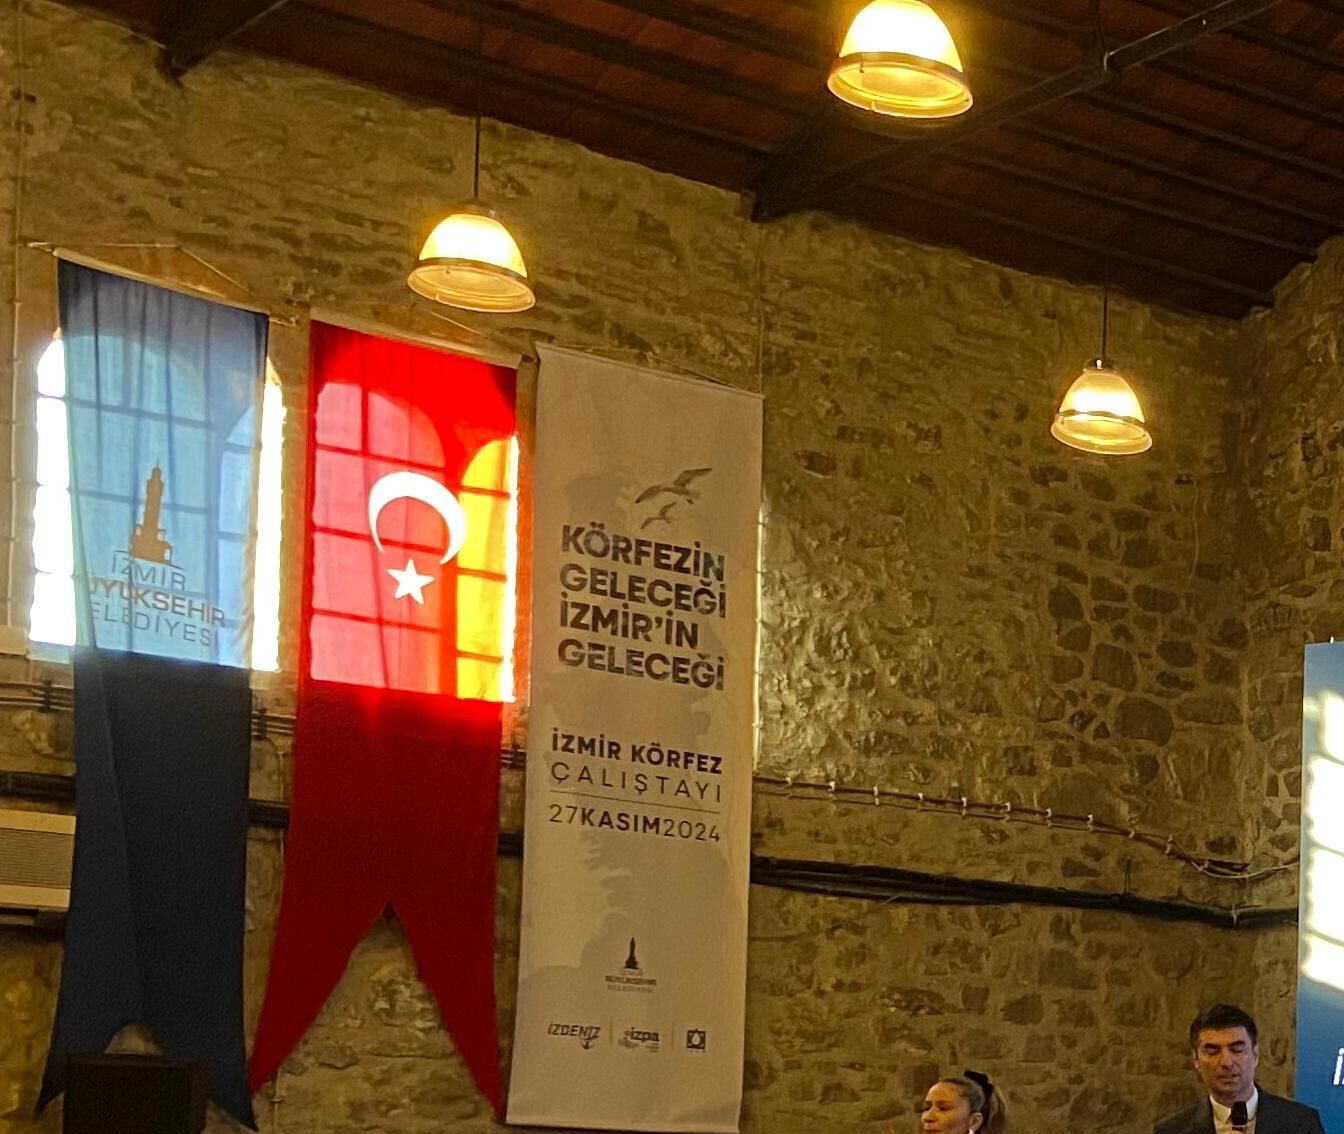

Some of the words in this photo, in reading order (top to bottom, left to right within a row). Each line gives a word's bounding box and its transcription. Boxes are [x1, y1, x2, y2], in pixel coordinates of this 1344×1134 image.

[561, 521, 726, 582] KÖRFEZİN
[559, 563, 727, 619] GELECEĞİ
[559, 591, 699, 650] İZMİR'İN
[557, 638, 725, 691] GELECEĞİ
[551, 727, 623, 761] İZMİR
[630, 742, 723, 775] KÖRFEZ
[550, 761, 721, 803] ÇALIŞTAYI
[548, 803, 721, 843] 27KASIM2024
